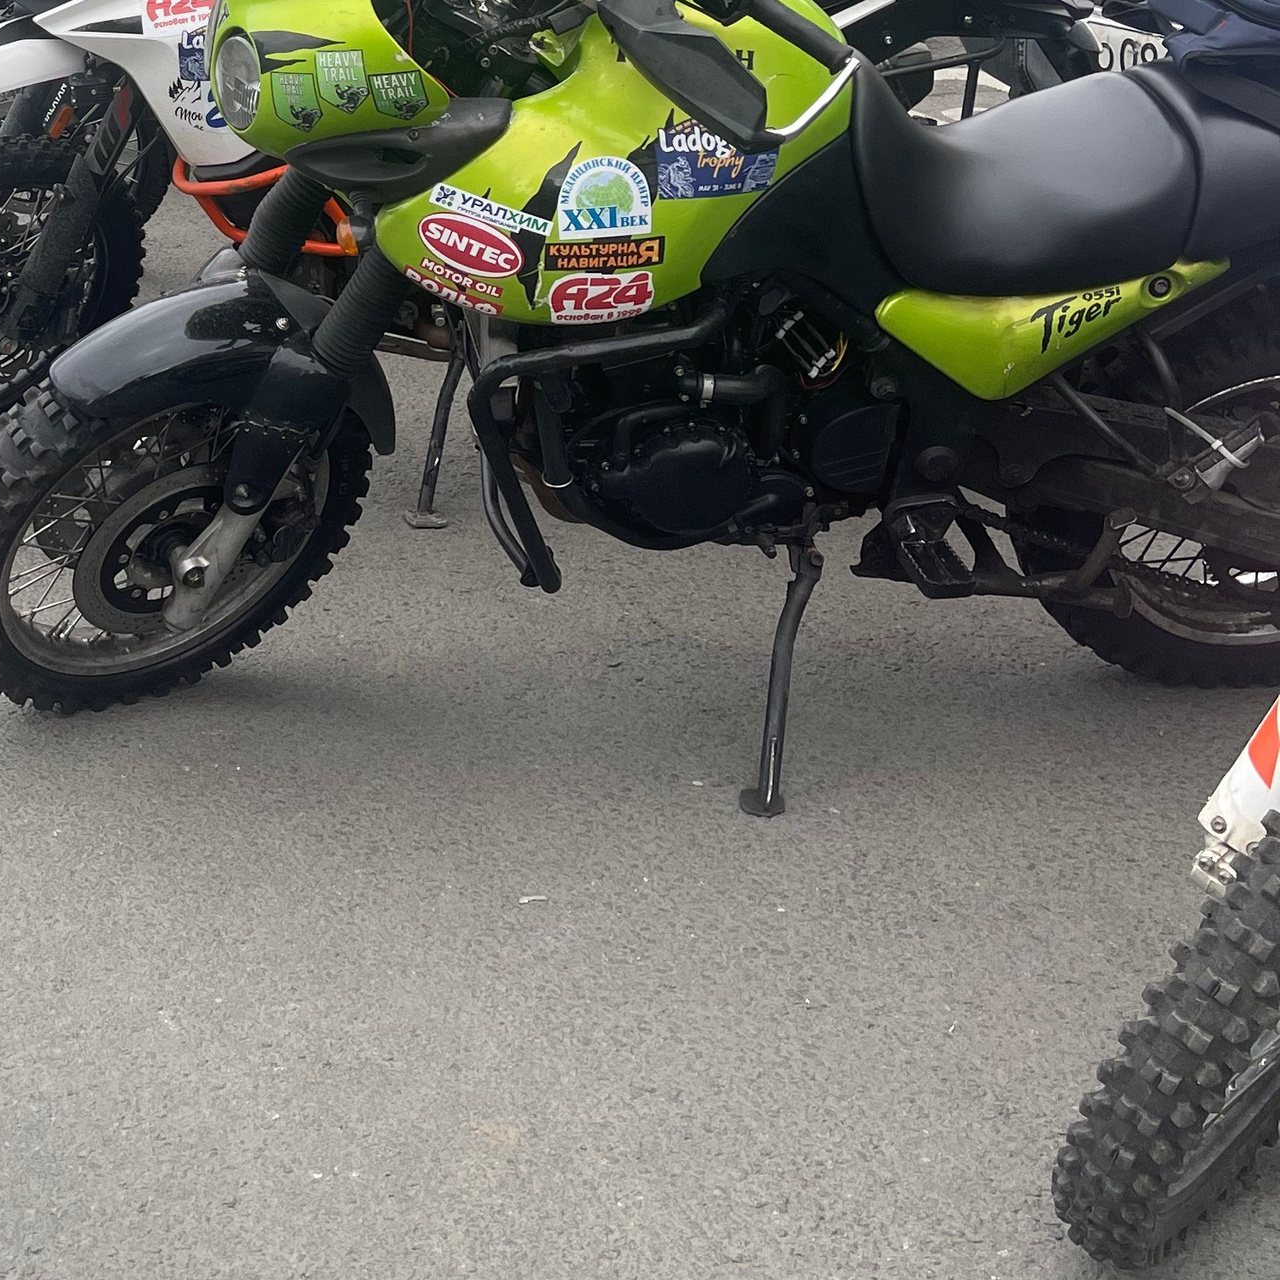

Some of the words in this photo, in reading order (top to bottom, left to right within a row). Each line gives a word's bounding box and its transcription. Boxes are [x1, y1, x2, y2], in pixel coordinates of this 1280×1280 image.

[320, 52, 358, 67] HEAVY
[279, 74, 304, 84] HEAVY
[323, 69, 358, 81] TRAIL
[373, 73, 416, 89] HEAVY
[282, 85, 303, 95] TRAIL
[380, 87, 417, 100] TRAIL
[658, 125, 737, 158] Ladog
[561, 157, 630, 205] МЕДИЦИНСКИЙ
[630, 169, 650, 207] ЦЕНТР
[698, 184, 711, 192] MAY
[461, 194, 548, 233] УРАЛХИМ
[562, 206, 619, 232] XXI
[620, 214, 649, 227] ВЕК
[425, 222, 515, 270] SINTEC
[421, 258, 473, 289] MOTOR
[475, 282, 500, 298] OIL
[405, 268, 497, 315] РОЛЬФ
[1082, 286, 1121, 303] 955i
[616, 307, 642, 318] 1999
[1030, 296, 1122, 355] Tiger
